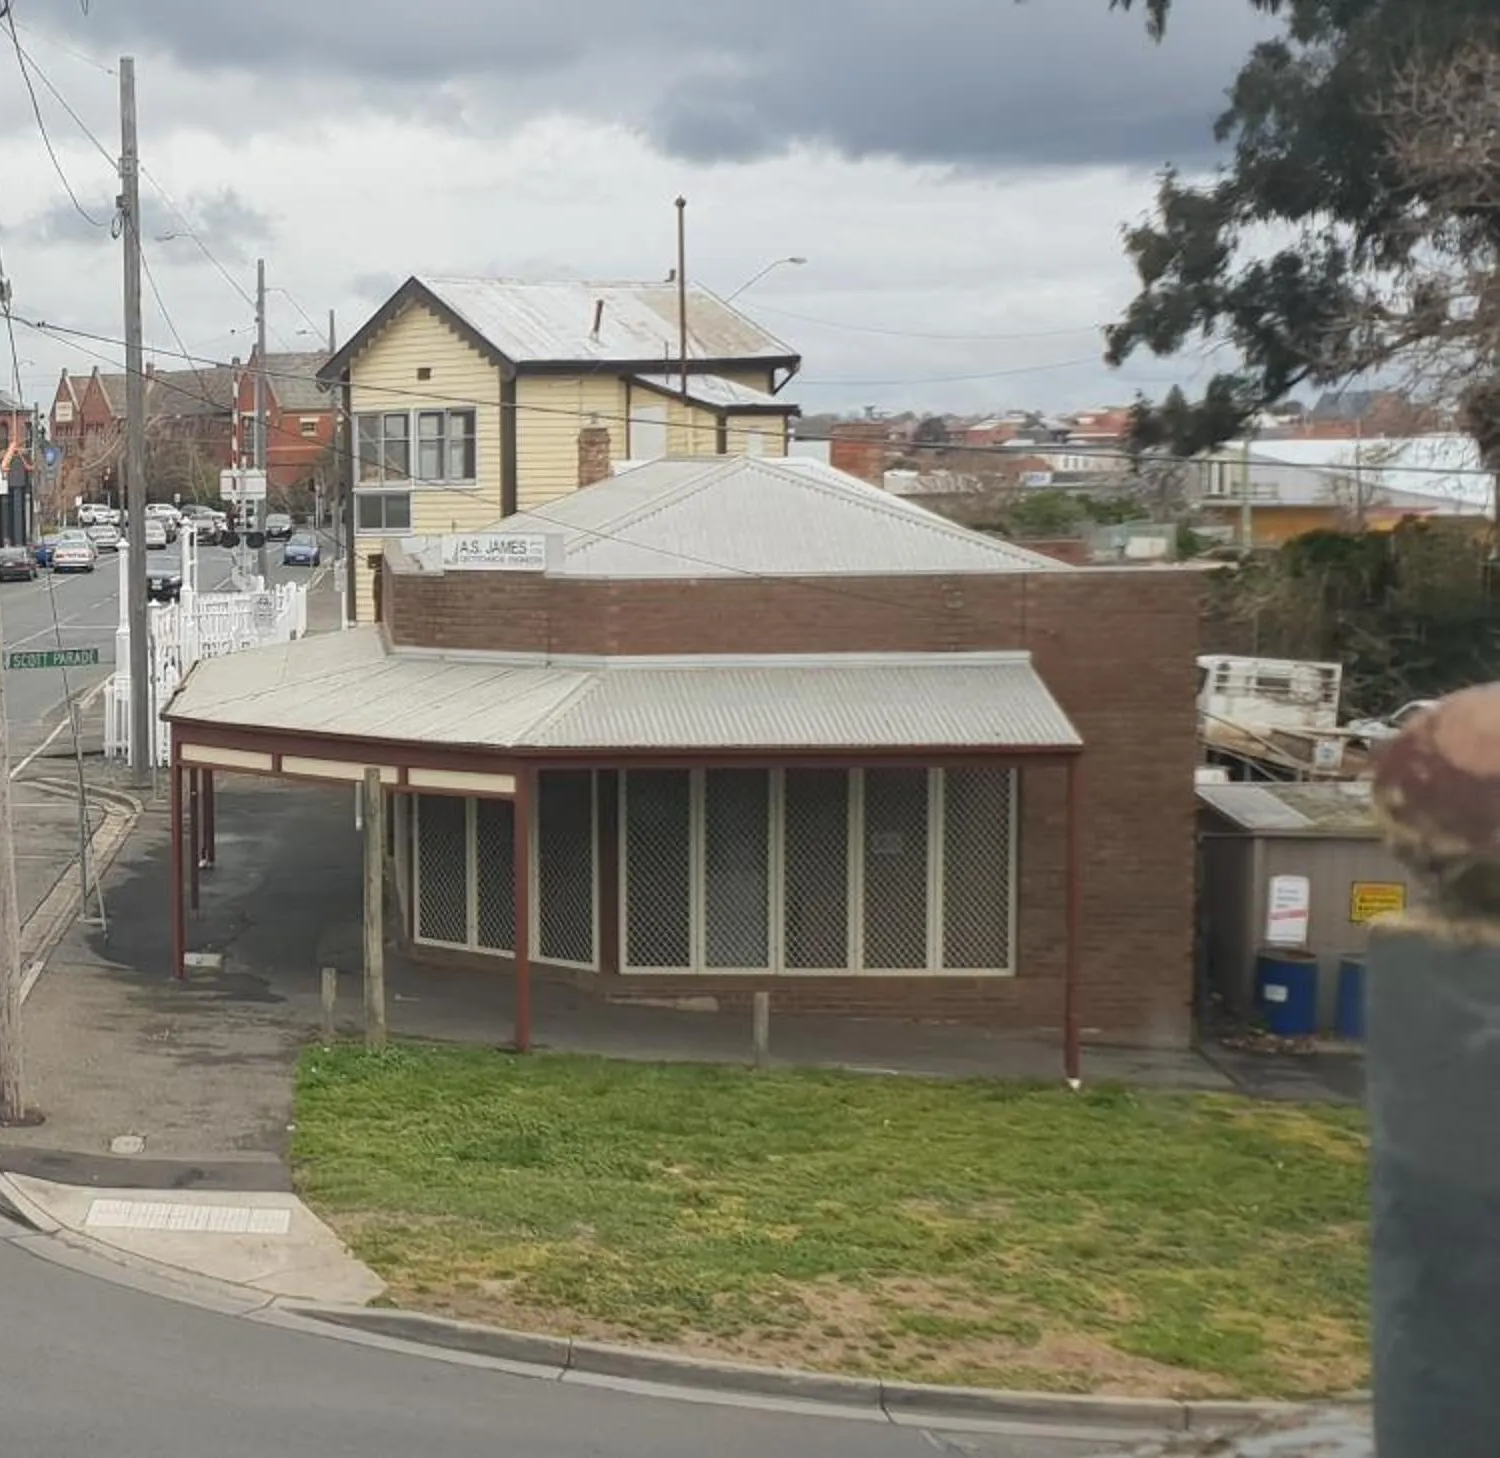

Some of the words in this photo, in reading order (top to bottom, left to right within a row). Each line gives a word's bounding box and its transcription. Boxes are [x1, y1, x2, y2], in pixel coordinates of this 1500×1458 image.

[485, 540, 527, 555] JAMES
[13, 653, 48, 667] SCOTT
[53, 650, 96, 665] PARADE
